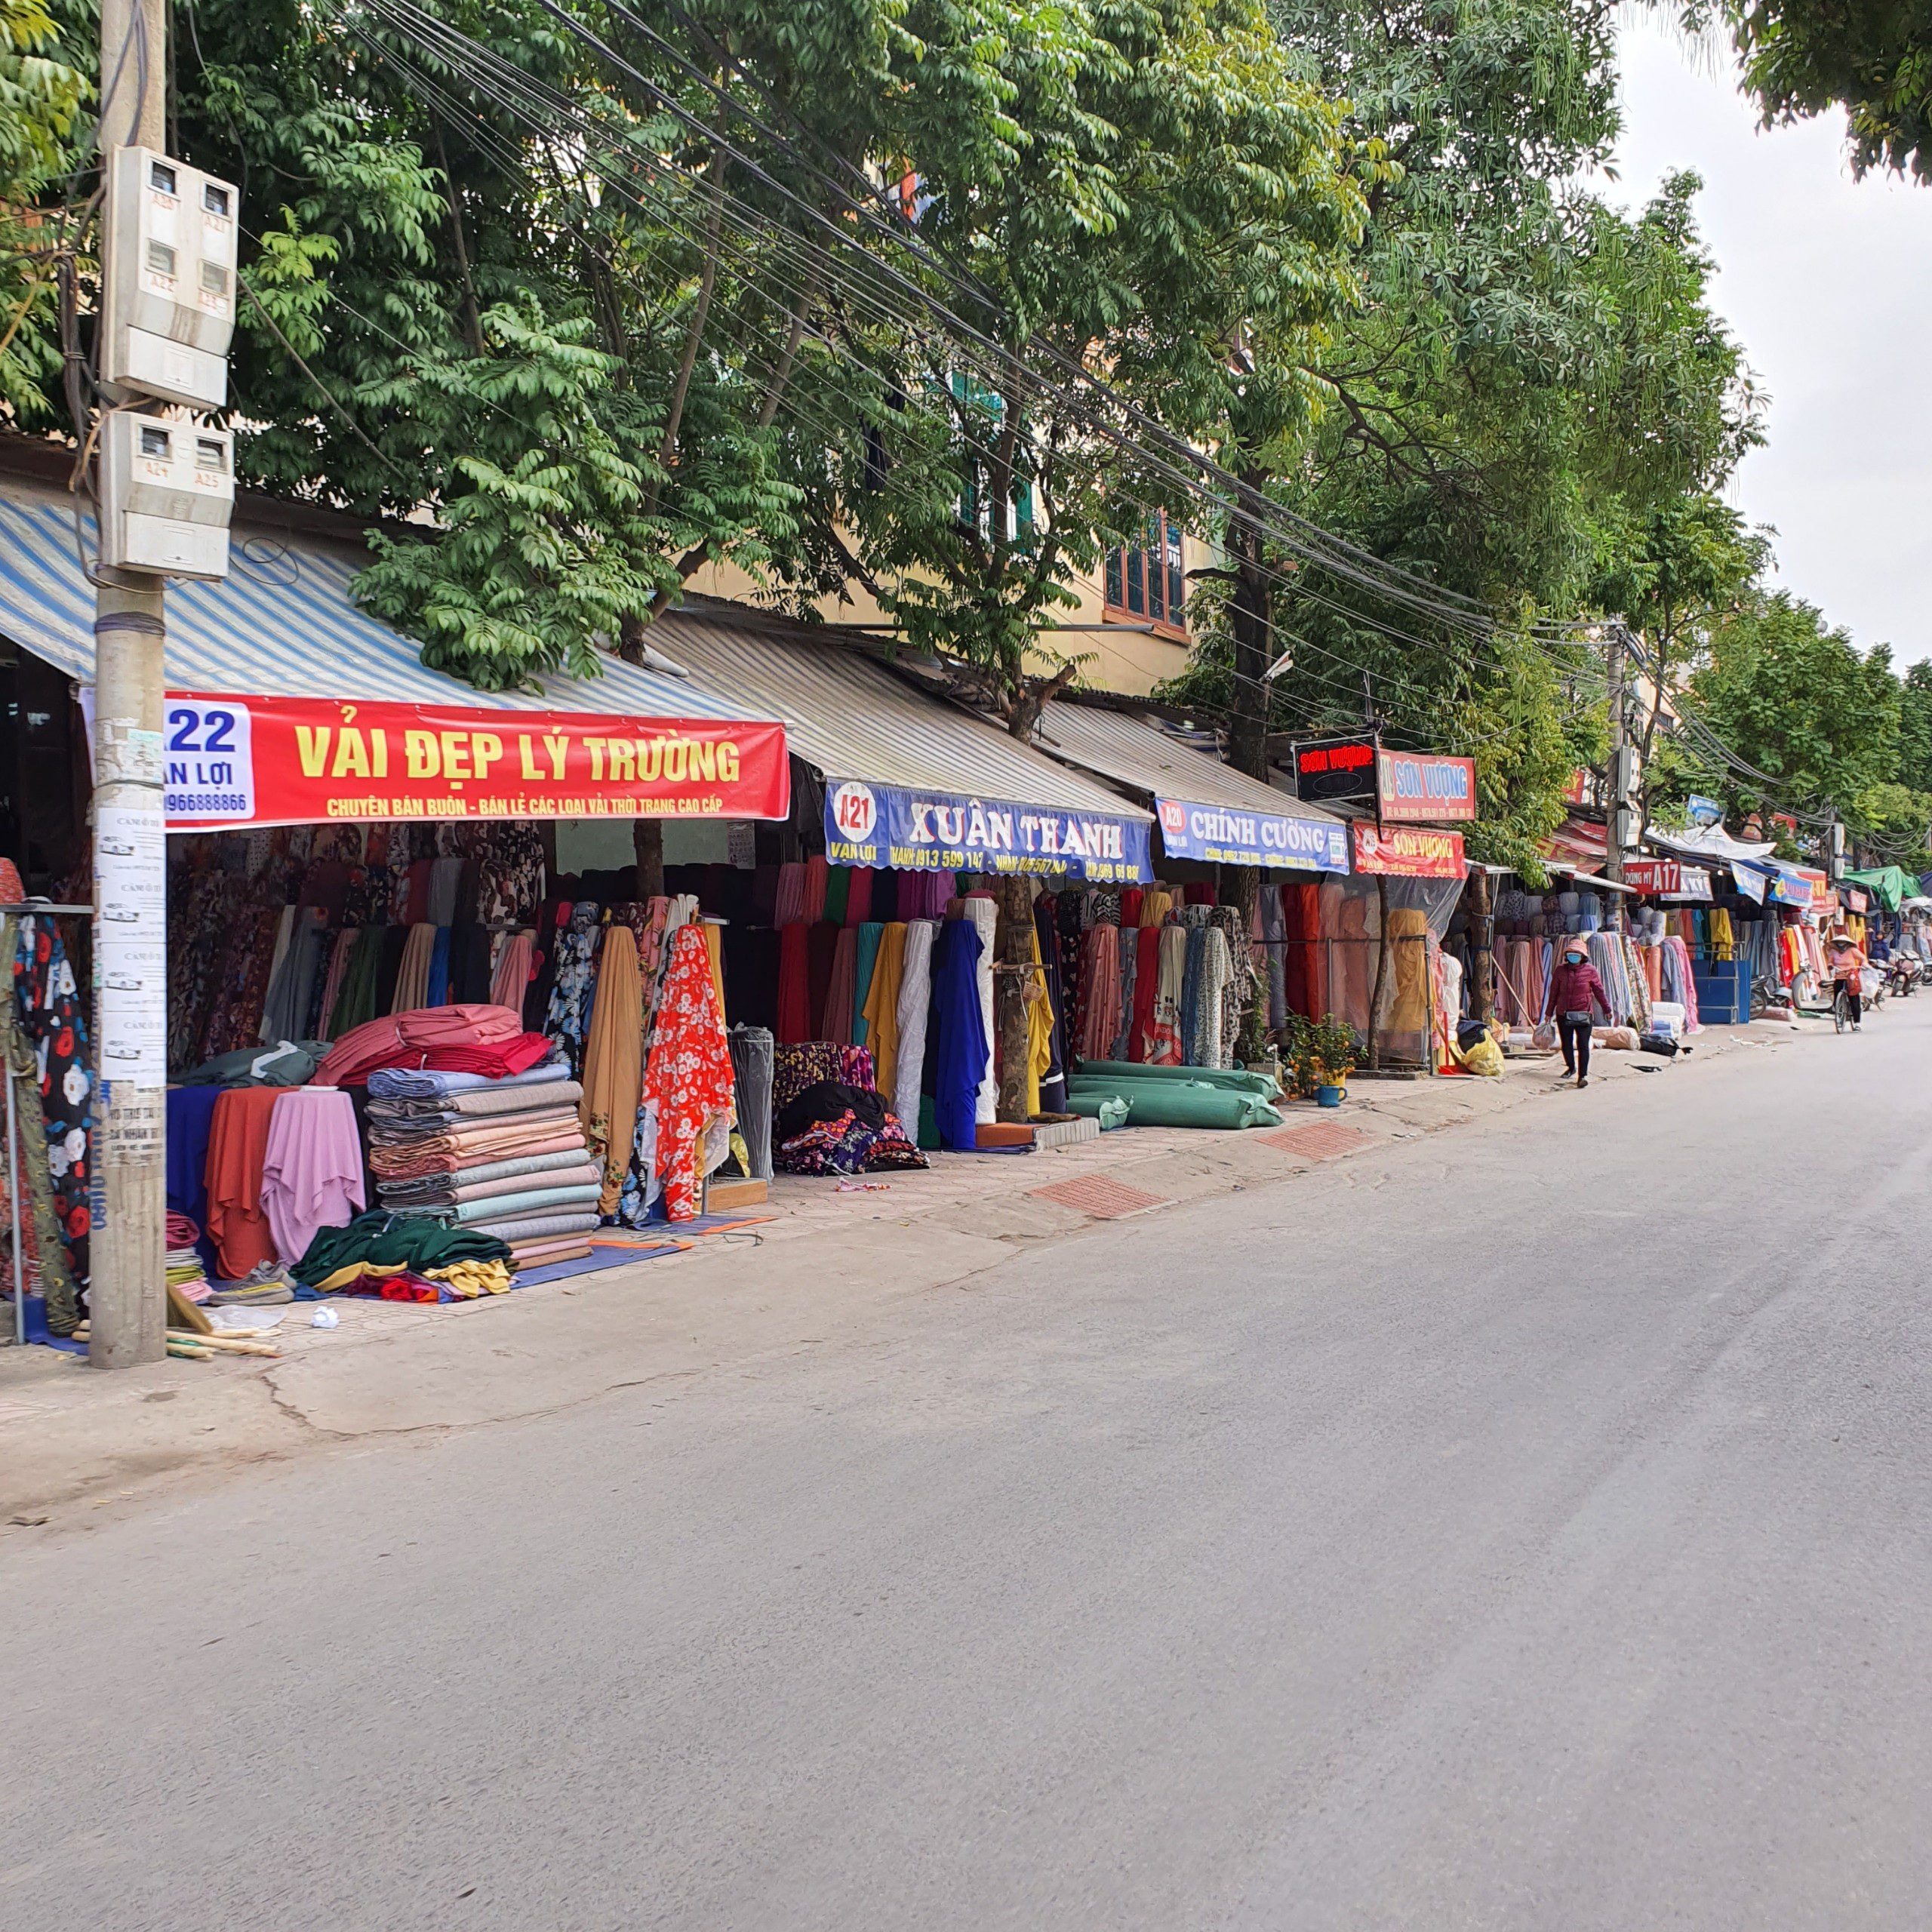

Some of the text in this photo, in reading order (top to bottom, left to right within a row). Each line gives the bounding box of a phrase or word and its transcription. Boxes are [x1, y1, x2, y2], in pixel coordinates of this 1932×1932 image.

[195, 472, 219, 489] A25
[165, 709, 235, 752] 22
[294, 705, 740, 790] VẢI ĐẸP LÝ TRƯỜNG
[195, 761, 233, 790] LỢI
[1395, 758, 1424, 798] SƠN
[1423, 761, 1468, 806] VƯỢNG
[165, 793, 246, 811] 966888866
[327, 795, 389, 817] CHUYÊN
[392, 794, 423, 817] BÁN
[427, 795, 467, 816] BUÔN
[478, 795, 508, 815] BÁN
[511, 792, 527, 815] LẺ
[529, 795, 556, 815] CÁC
[558, 798, 586, 817] LOẠI
[588, 792, 608, 815] VẢI
[610, 794, 636, 814] THỜI
[638, 797, 676, 814] TRANG
[677, 798, 700, 814] CAO
[701, 794, 724, 814] CẤP
[839, 793, 1123, 859] A21 XUÂN THANH
[1165, 805, 1326, 854] A20 CHÍNH CƯỜNG
[830, 841, 858, 863] VẠN
[858, 844, 877, 864] LỢI
[941, 850, 964, 868] 599
[1653, 863, 1679, 891] A17
